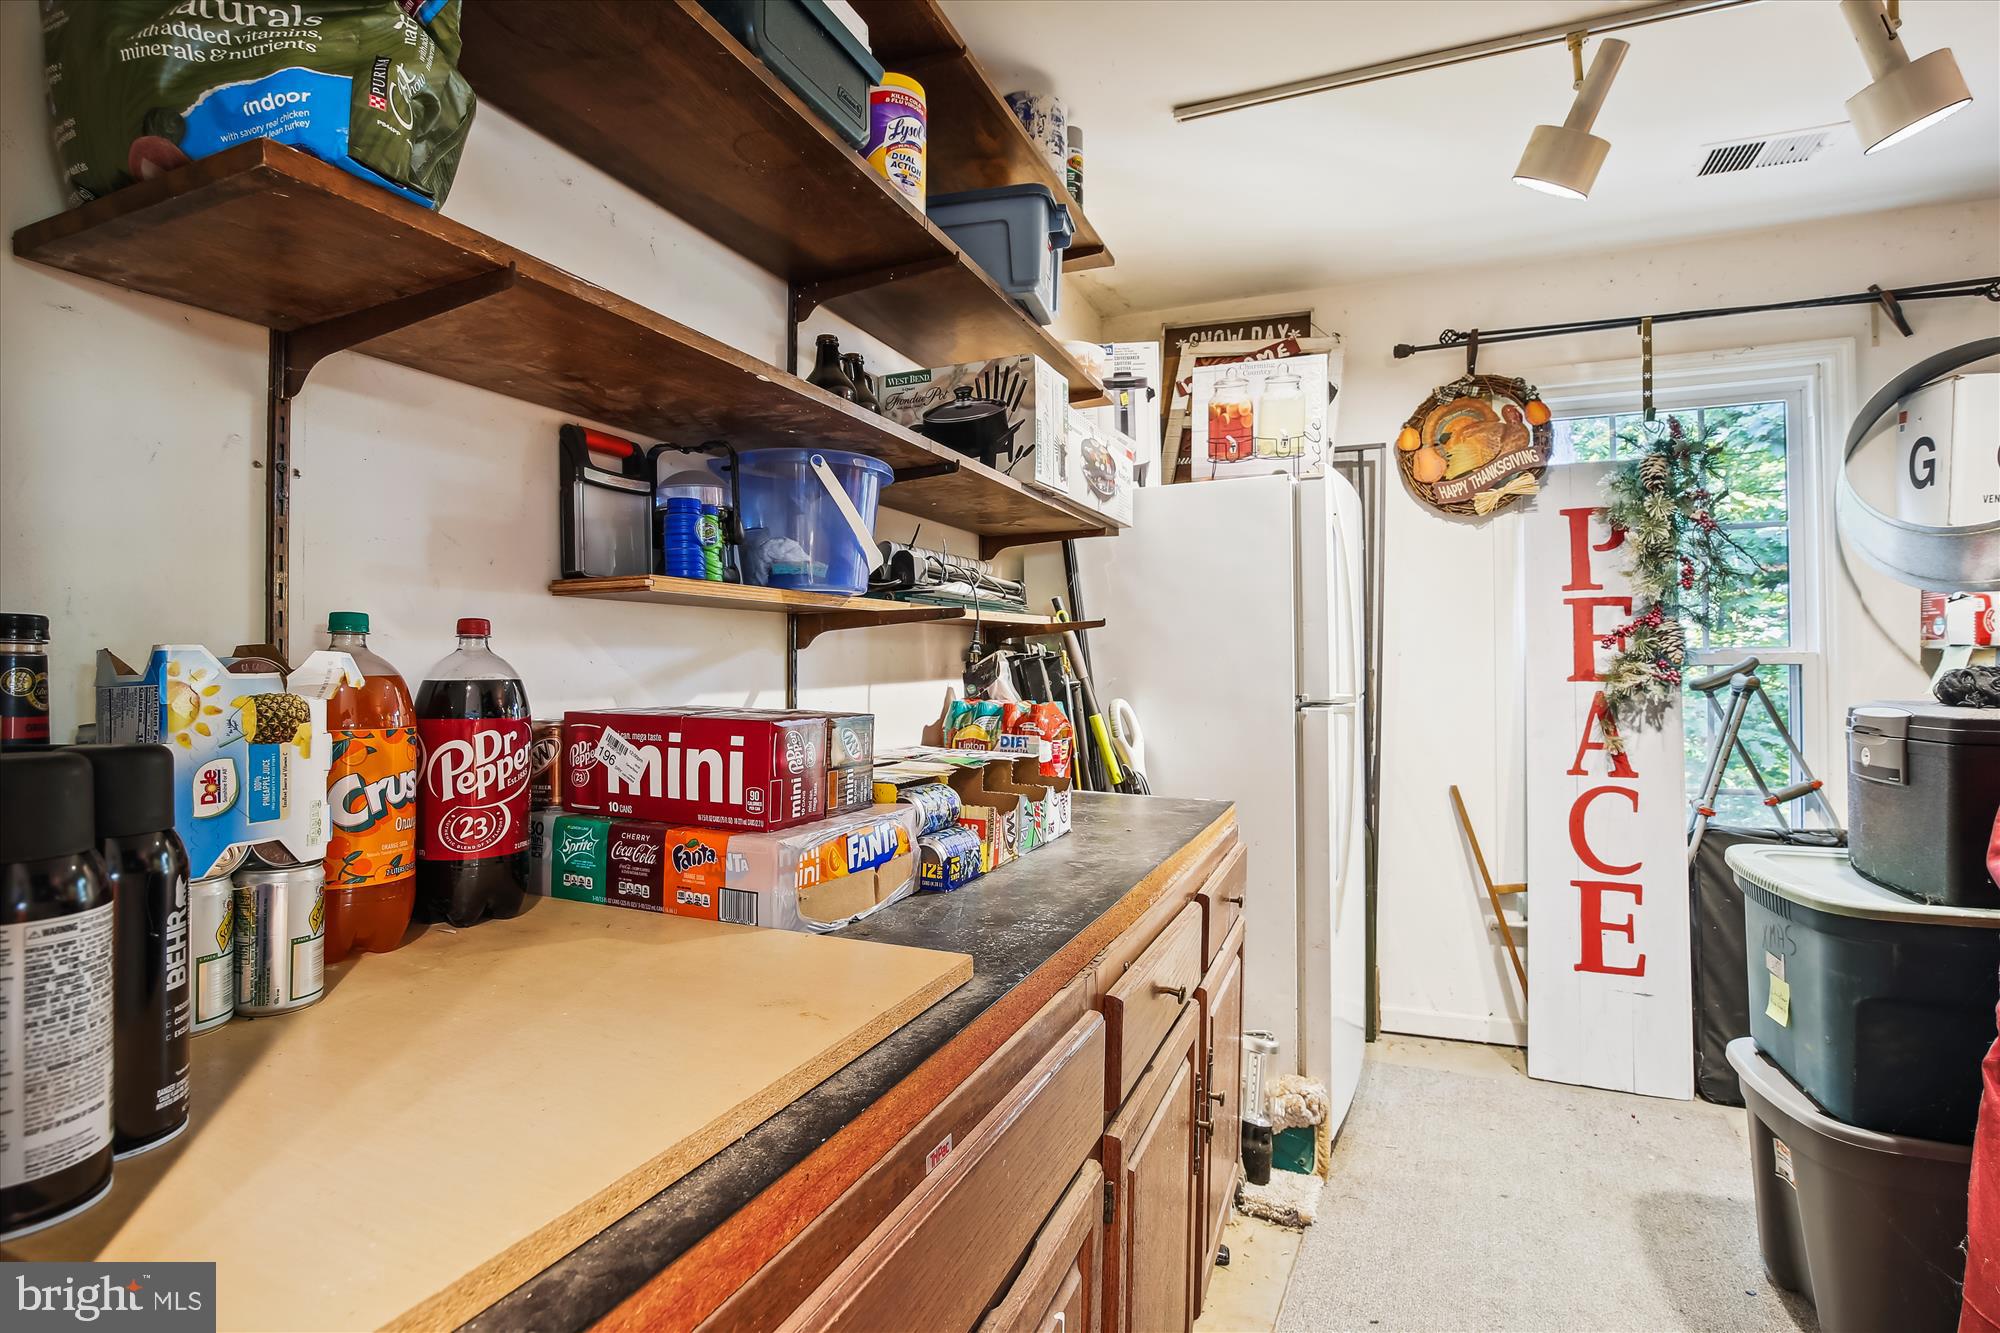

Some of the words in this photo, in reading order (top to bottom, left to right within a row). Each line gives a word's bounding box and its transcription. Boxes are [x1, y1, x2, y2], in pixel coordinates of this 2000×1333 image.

[161, 21, 231, 46] added
[234, 29, 323, 45] vitamins,
[120, 42, 206, 62] minerals
[209, 49, 226, 61] &
[228, 40, 317, 60] nutrients
[373, 58, 390, 97] PURINA
[243, 91, 311, 116] indoor
[890, 92, 909, 102] KILLS
[891, 98, 904, 106] FLU
[220, 132, 239, 143] with
[240, 125, 264, 138] savory
[265, 118, 278, 130] real
[279, 110, 310, 123] chicken
[284, 120, 311, 132] turkey
[888, 118, 922, 143] Lysol
[890, 161, 922, 177] ACTION
[891, 152, 916, 165] DUAL
[1189, 328, 1243, 343] SNOW
[1251, 323, 1290, 341] DAY
[887, 376, 909, 386] WEST
[909, 374, 930, 384] BEND
[1242, 369, 1272, 377] Country
[885, 390, 926, 411] Fondue
[922, 386, 950, 406] Pot
[1438, 479, 1469, 500] HAPPY
[1468, 449, 1540, 491] THANKSGIVING
[1909, 436, 1937, 490] G
[472, 729, 518, 766] Dr
[579, 741, 592, 752] Dr
[631, 733, 646, 742] mega
[958, 740, 986, 751] Lipton
[1000, 736, 1029, 748] DIET
[1559, 507, 1646, 977] PEACE
[599, 746, 617, 766] 196
[788, 731, 804, 774] Pepper
[262, 759, 271, 776] JUICE
[430, 740, 531, 802] Pepper
[607, 731, 744, 805] mini
[200, 769, 217, 806] Dole
[262, 777, 271, 807] PINEAPPLE
[749, 790, 760, 801] 90
[790, 777, 802, 818] mini
[845, 768, 854, 805] mini
[608, 801, 619, 812] 10
[619, 804, 633, 814] CANS
[443, 819, 456, 847] AUTHENTIC
[456, 842, 477, 851] BLEND
[476, 842, 485, 850] OF
[460, 816, 488, 840] 23
[621, 832, 651, 842] CHERRY
[562, 838, 594, 854] Sprite
[611, 840, 660, 865] Coca-Cola
[672, 842, 718, 873] Fanta
[847, 823, 897, 870] FANTA
[921, 863, 936, 879] 12
[42, 923, 79, 937] WARNING
[1762, 924, 1797, 956] XMAS
[166, 911, 187, 992] BEHR
